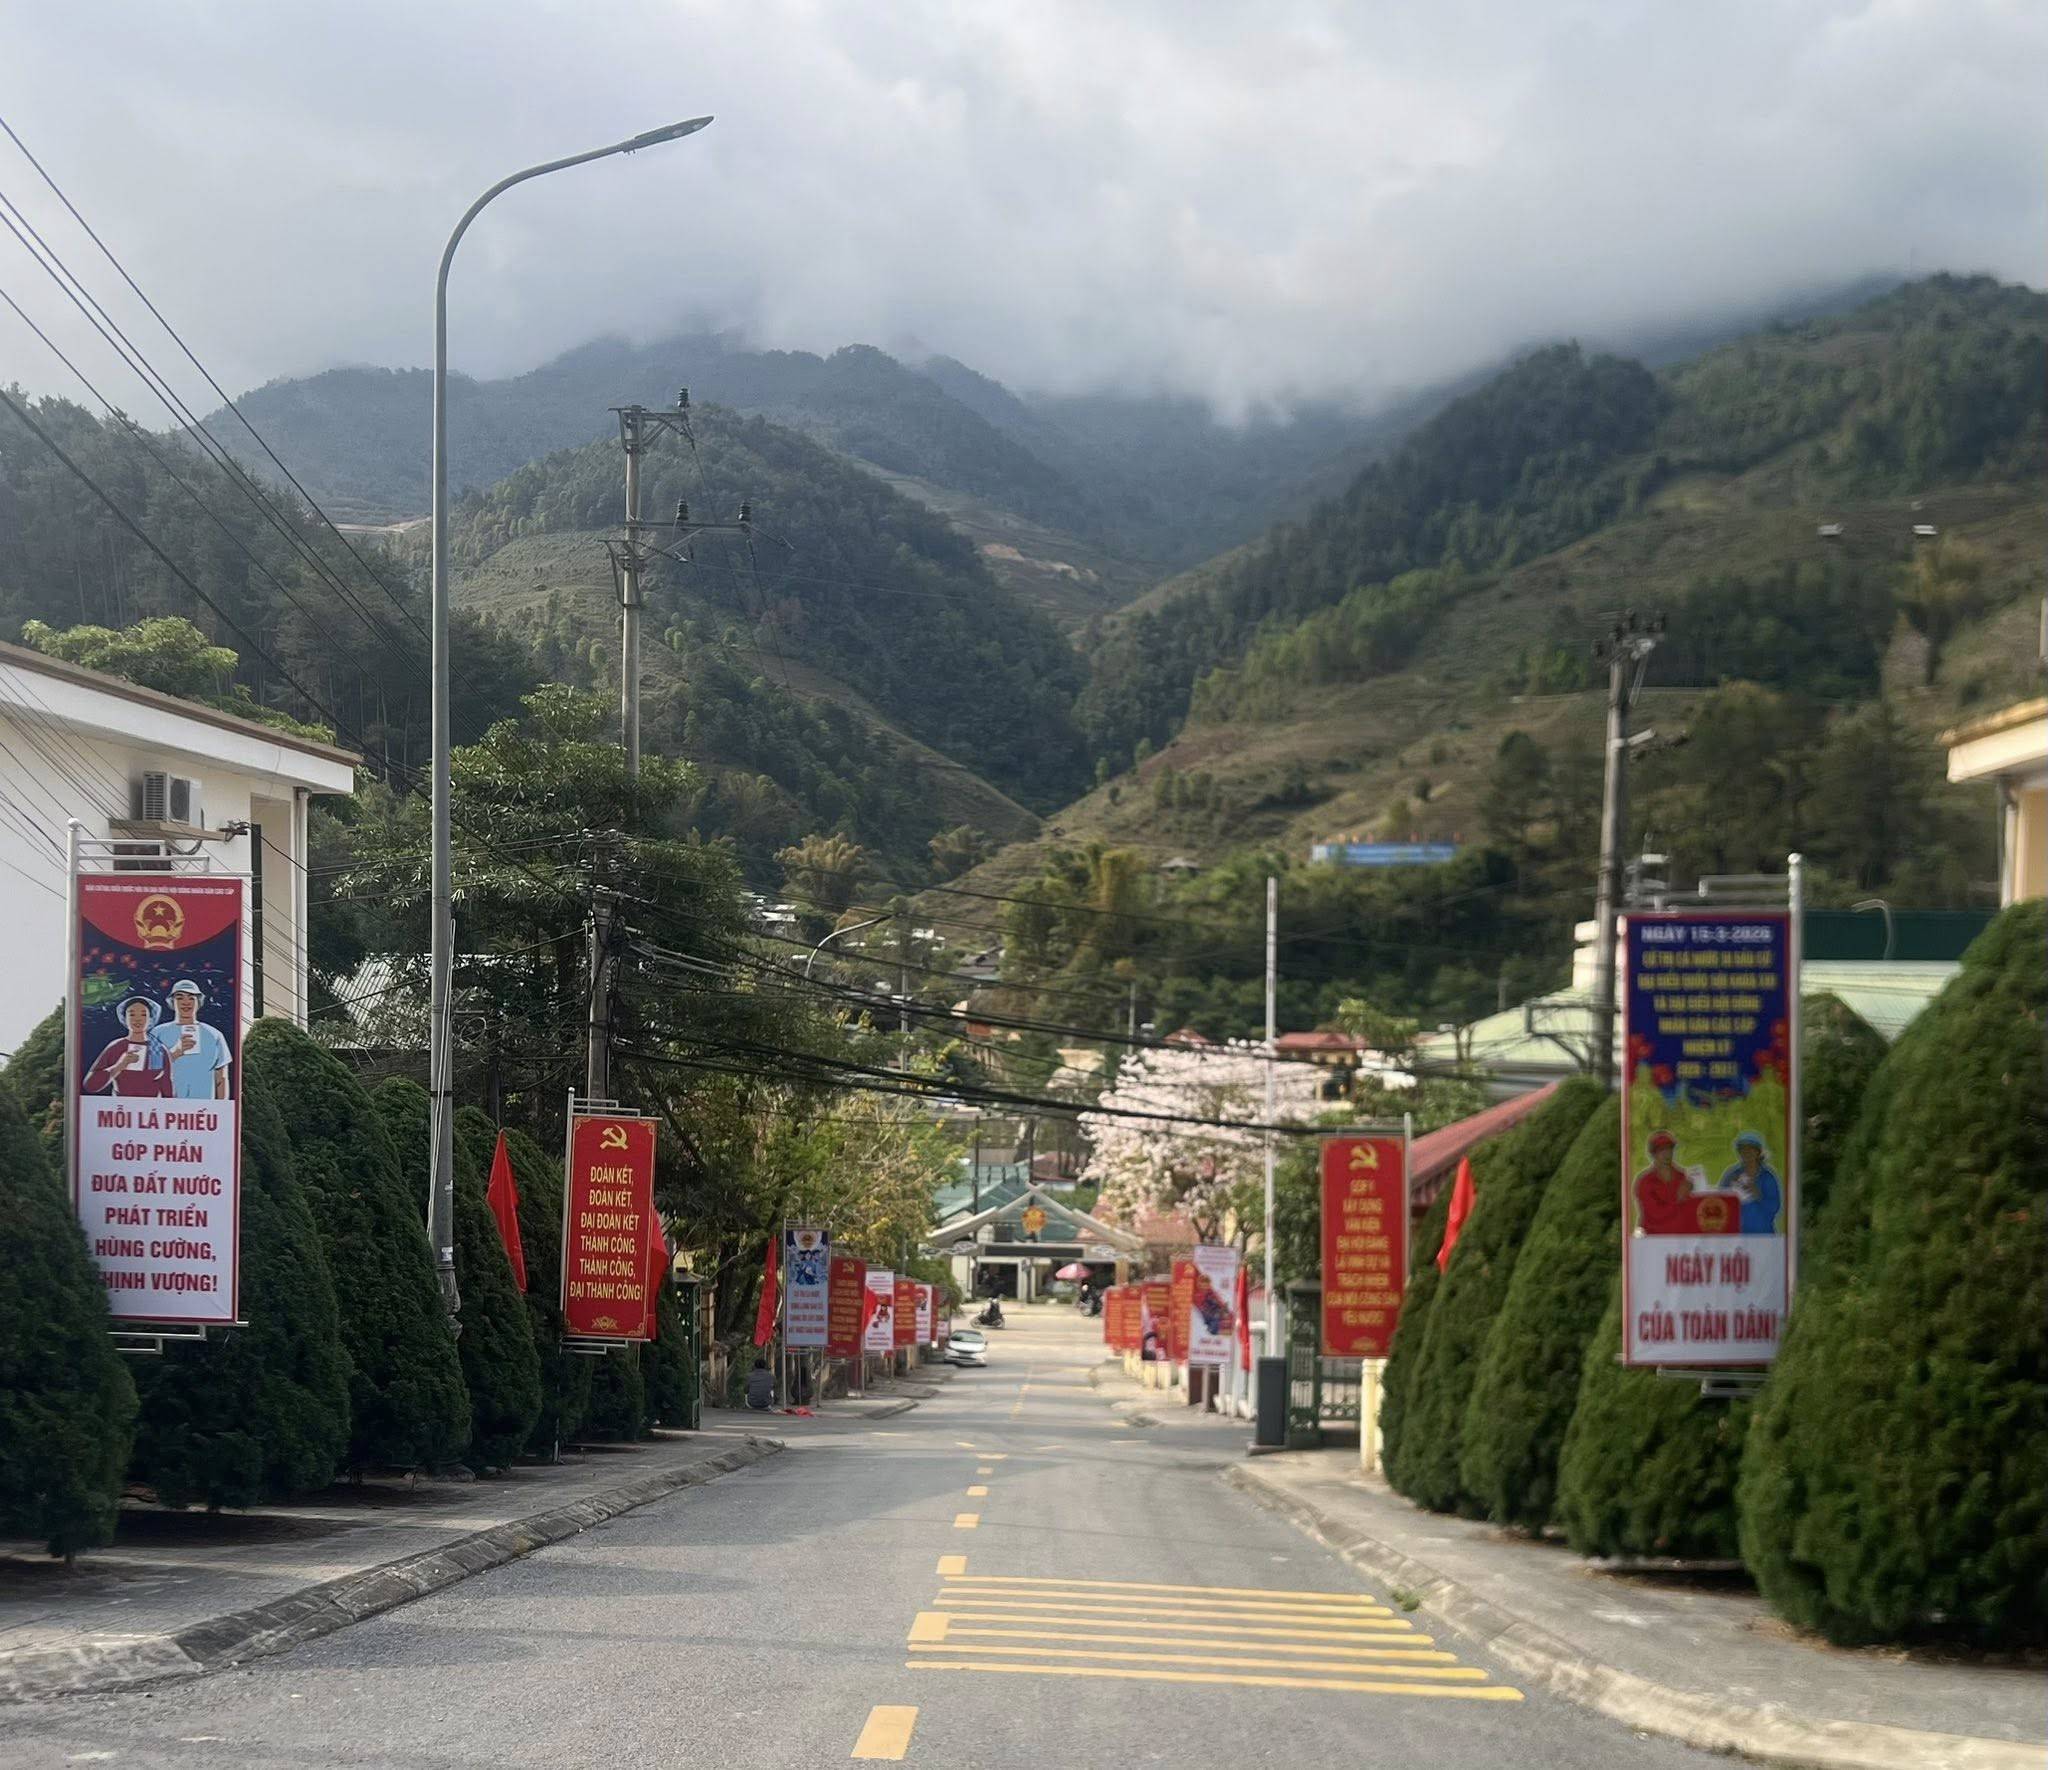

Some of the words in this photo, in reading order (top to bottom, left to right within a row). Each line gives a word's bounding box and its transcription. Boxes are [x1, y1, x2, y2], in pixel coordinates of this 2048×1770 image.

[98, 1105, 132, 1129] MỖI
[138, 1108, 160, 1130] LÁ
[165, 1108, 218, 1132] PHIẾU
[112, 1139, 148, 1162] GÓP
[153, 1139, 203, 1163] PHẦN
[91, 1173, 128, 1193] ĐƯA
[133, 1170, 168, 1194] ĐẤT
[173, 1174, 222, 1196] NƯỚC
[590, 1162, 615, 1184] ĐOÀN
[589, 1186, 613, 1207] ĐOÀN
[105, 1204, 151, 1226] PHÁT
[156, 1203, 208, 1227] TRIỂN
[580, 1212, 596, 1232] ĐẠI
[597, 1210, 621, 1230] ĐOÀN
[95, 1235, 145, 1257] HÙNG
[151, 1237, 217, 1262] CƯỜNG,
[580, 1231, 609, 1253] THÀNH
[610, 1234, 638, 1256] CÔNG,
[579, 1254, 608, 1276] THÀNH
[609, 1256, 636, 1279] CÔNG,
[1665, 1246, 1715, 1285] NGÀY
[1720, 1247, 1750, 1294] HỘI
[99, 1271, 145, 1293] HỊNH
[151, 1272, 218, 1295] VƯỢNG!
[570, 1281, 585, 1301] ĐẠI
[586, 1278, 615, 1299] THÀNH
[616, 1280, 643, 1301] CÔNG!
[1638, 1301, 1675, 1342] CỦA
[1680, 1303, 1728, 1342] TOÀN
[1733, 1303, 1777, 1342] DÂN!
